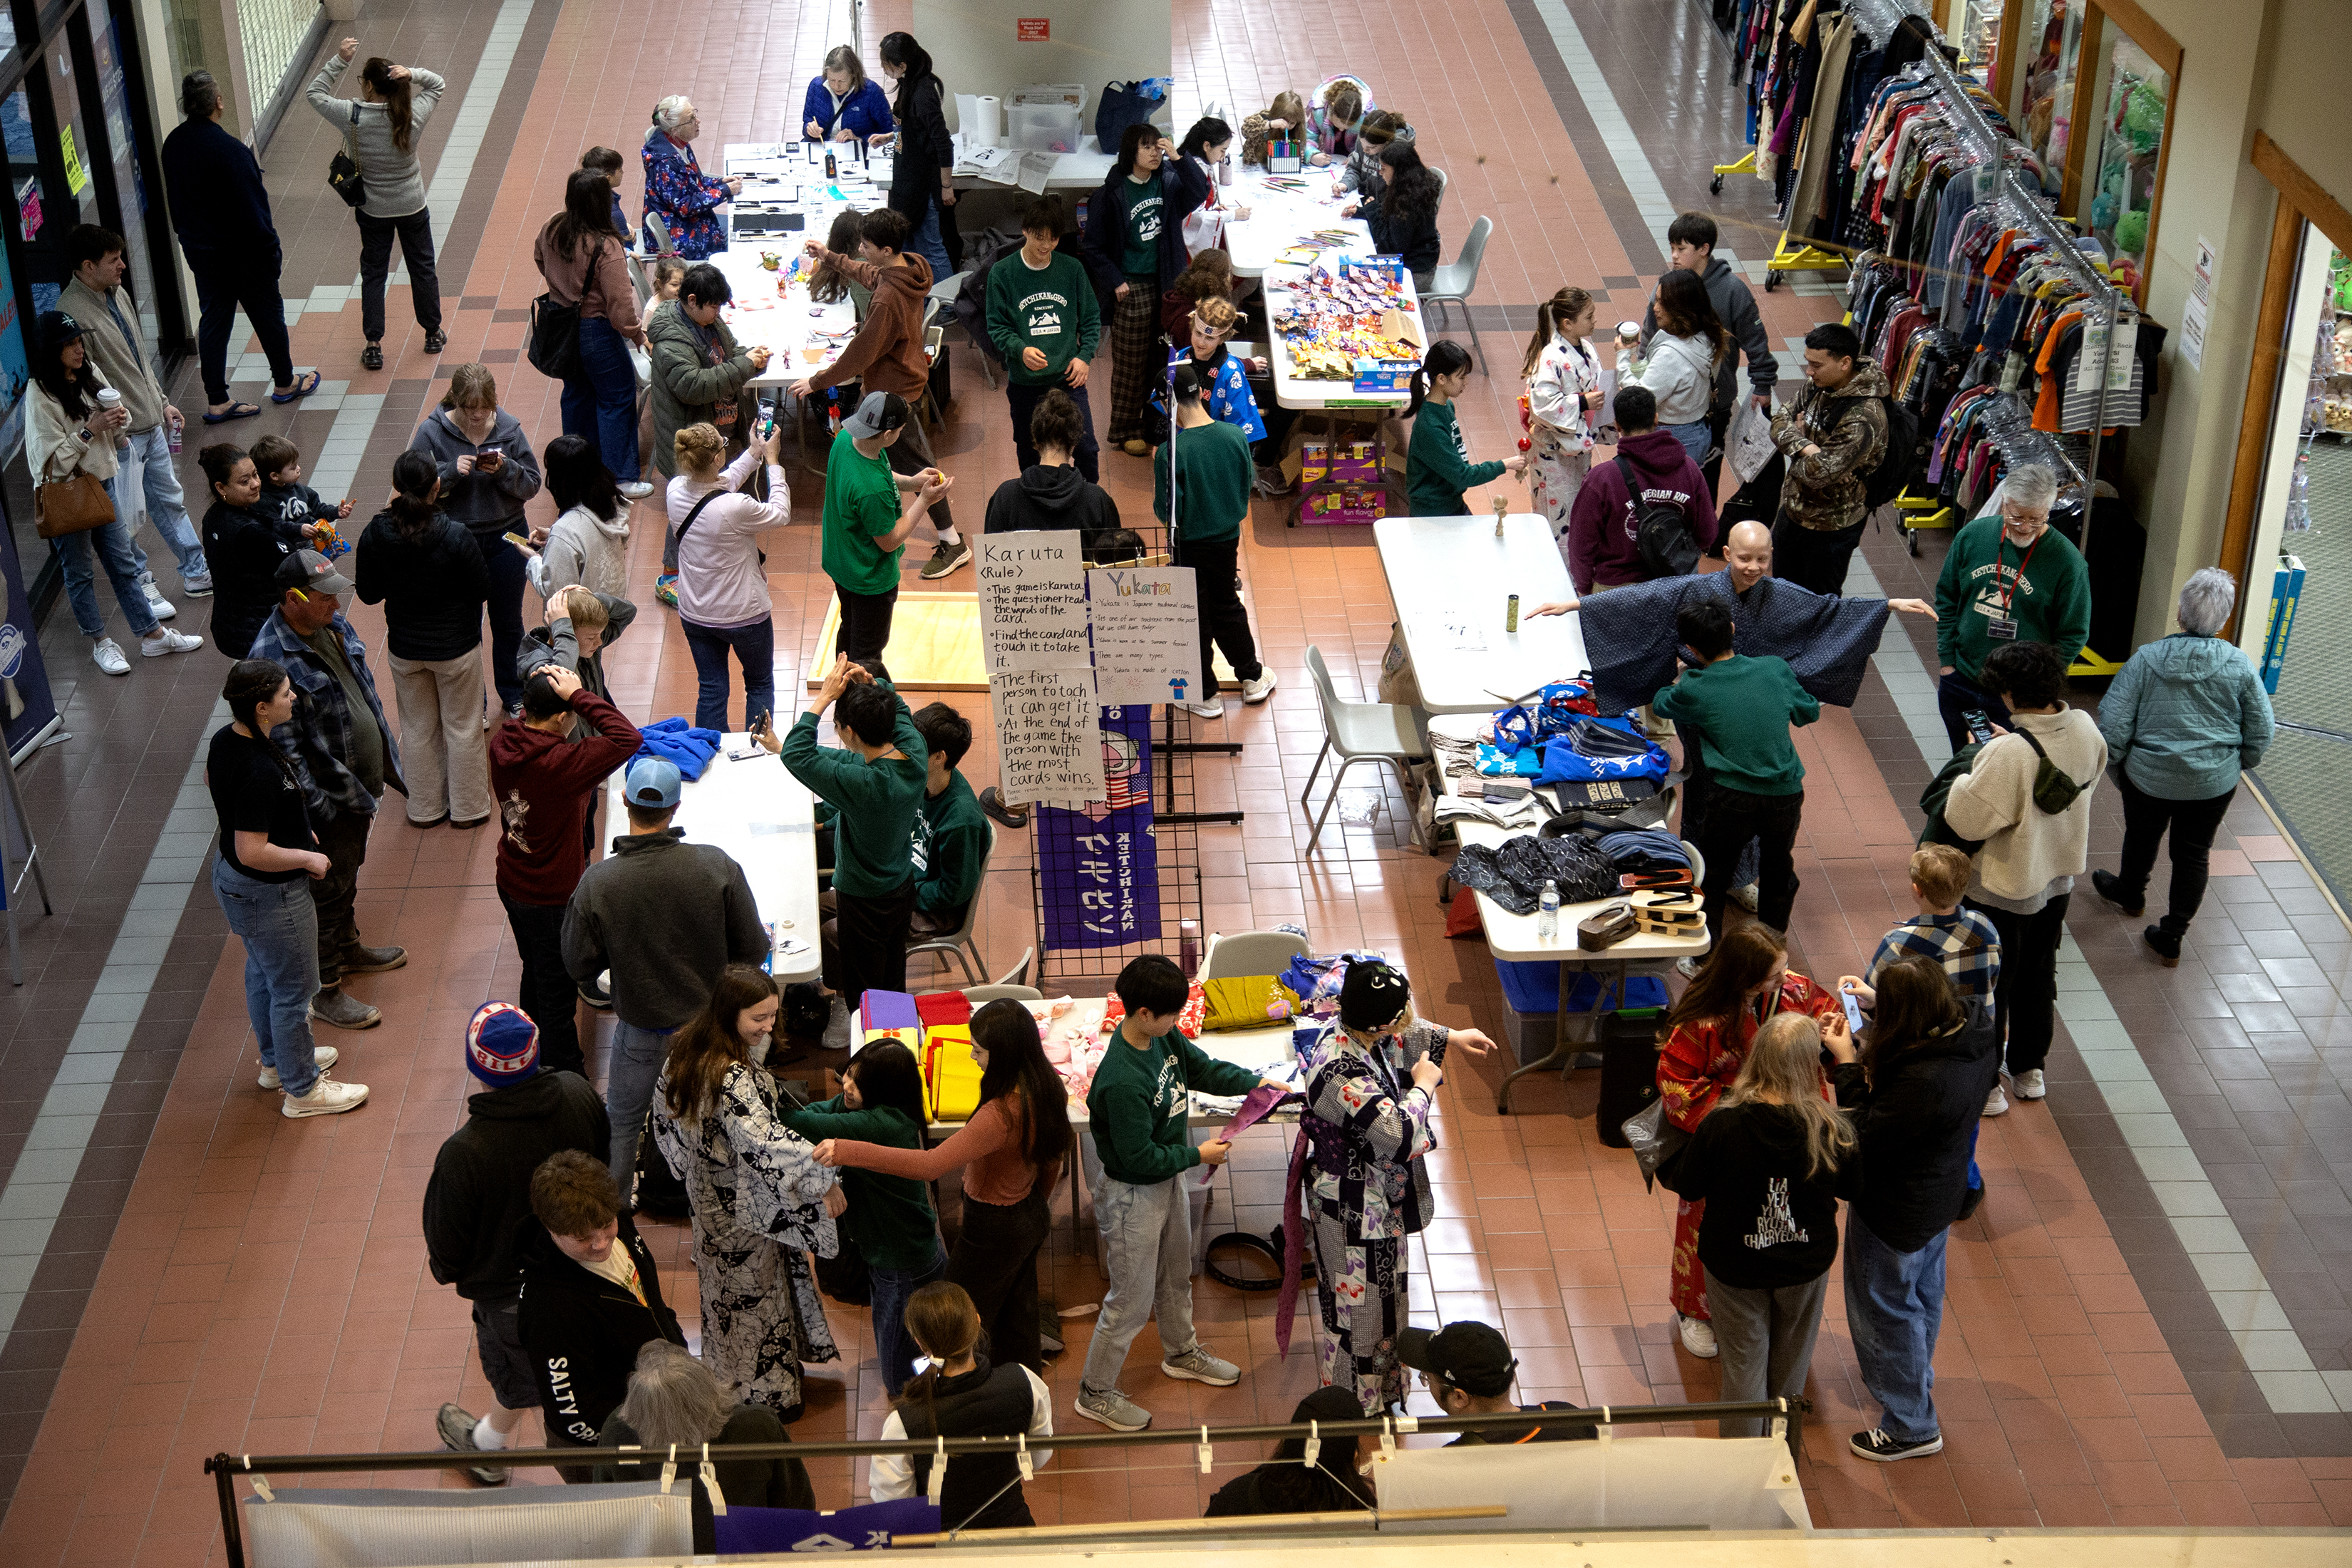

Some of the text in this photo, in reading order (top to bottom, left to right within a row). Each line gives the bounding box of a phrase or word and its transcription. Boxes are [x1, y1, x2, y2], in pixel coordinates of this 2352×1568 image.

[1672, 491, 1691, 504] RAT
[984, 544, 1064, 562] Karuta
[991, 584, 1011, 594] This
[1049, 581, 1084, 590] Karuta.
[1107, 571, 1172, 597] Yukata
[993, 594, 1009, 604] The
[1012, 595, 1064, 606] questioner
[1098, 598, 1120, 607] Yukata
[994, 604, 1011, 614] the
[1051, 605, 1067, 615] the
[994, 614, 1027, 624] card.
[995, 629, 1018, 641] Find
[994, 641, 1080, 653] touch it to take
[996, 654, 1011, 667] it.
[999, 670, 1060, 688] The first
[1002, 686, 1037, 706] person
[1043, 686, 1056, 697] to
[1004, 699, 1091, 716] it can get it
[1004, 715, 1090, 730] At the end of
[1003, 729, 1082, 744] the game the
[1006, 743, 1080, 760] person with
[1007, 758, 1071, 772] the most
[1010, 770, 1095, 787] cards wins.
[914, 857, 927, 870] JAPAN
[1175, 1102, 1187, 1113] JAPA
[548, 1356, 579, 1414] SALTY
